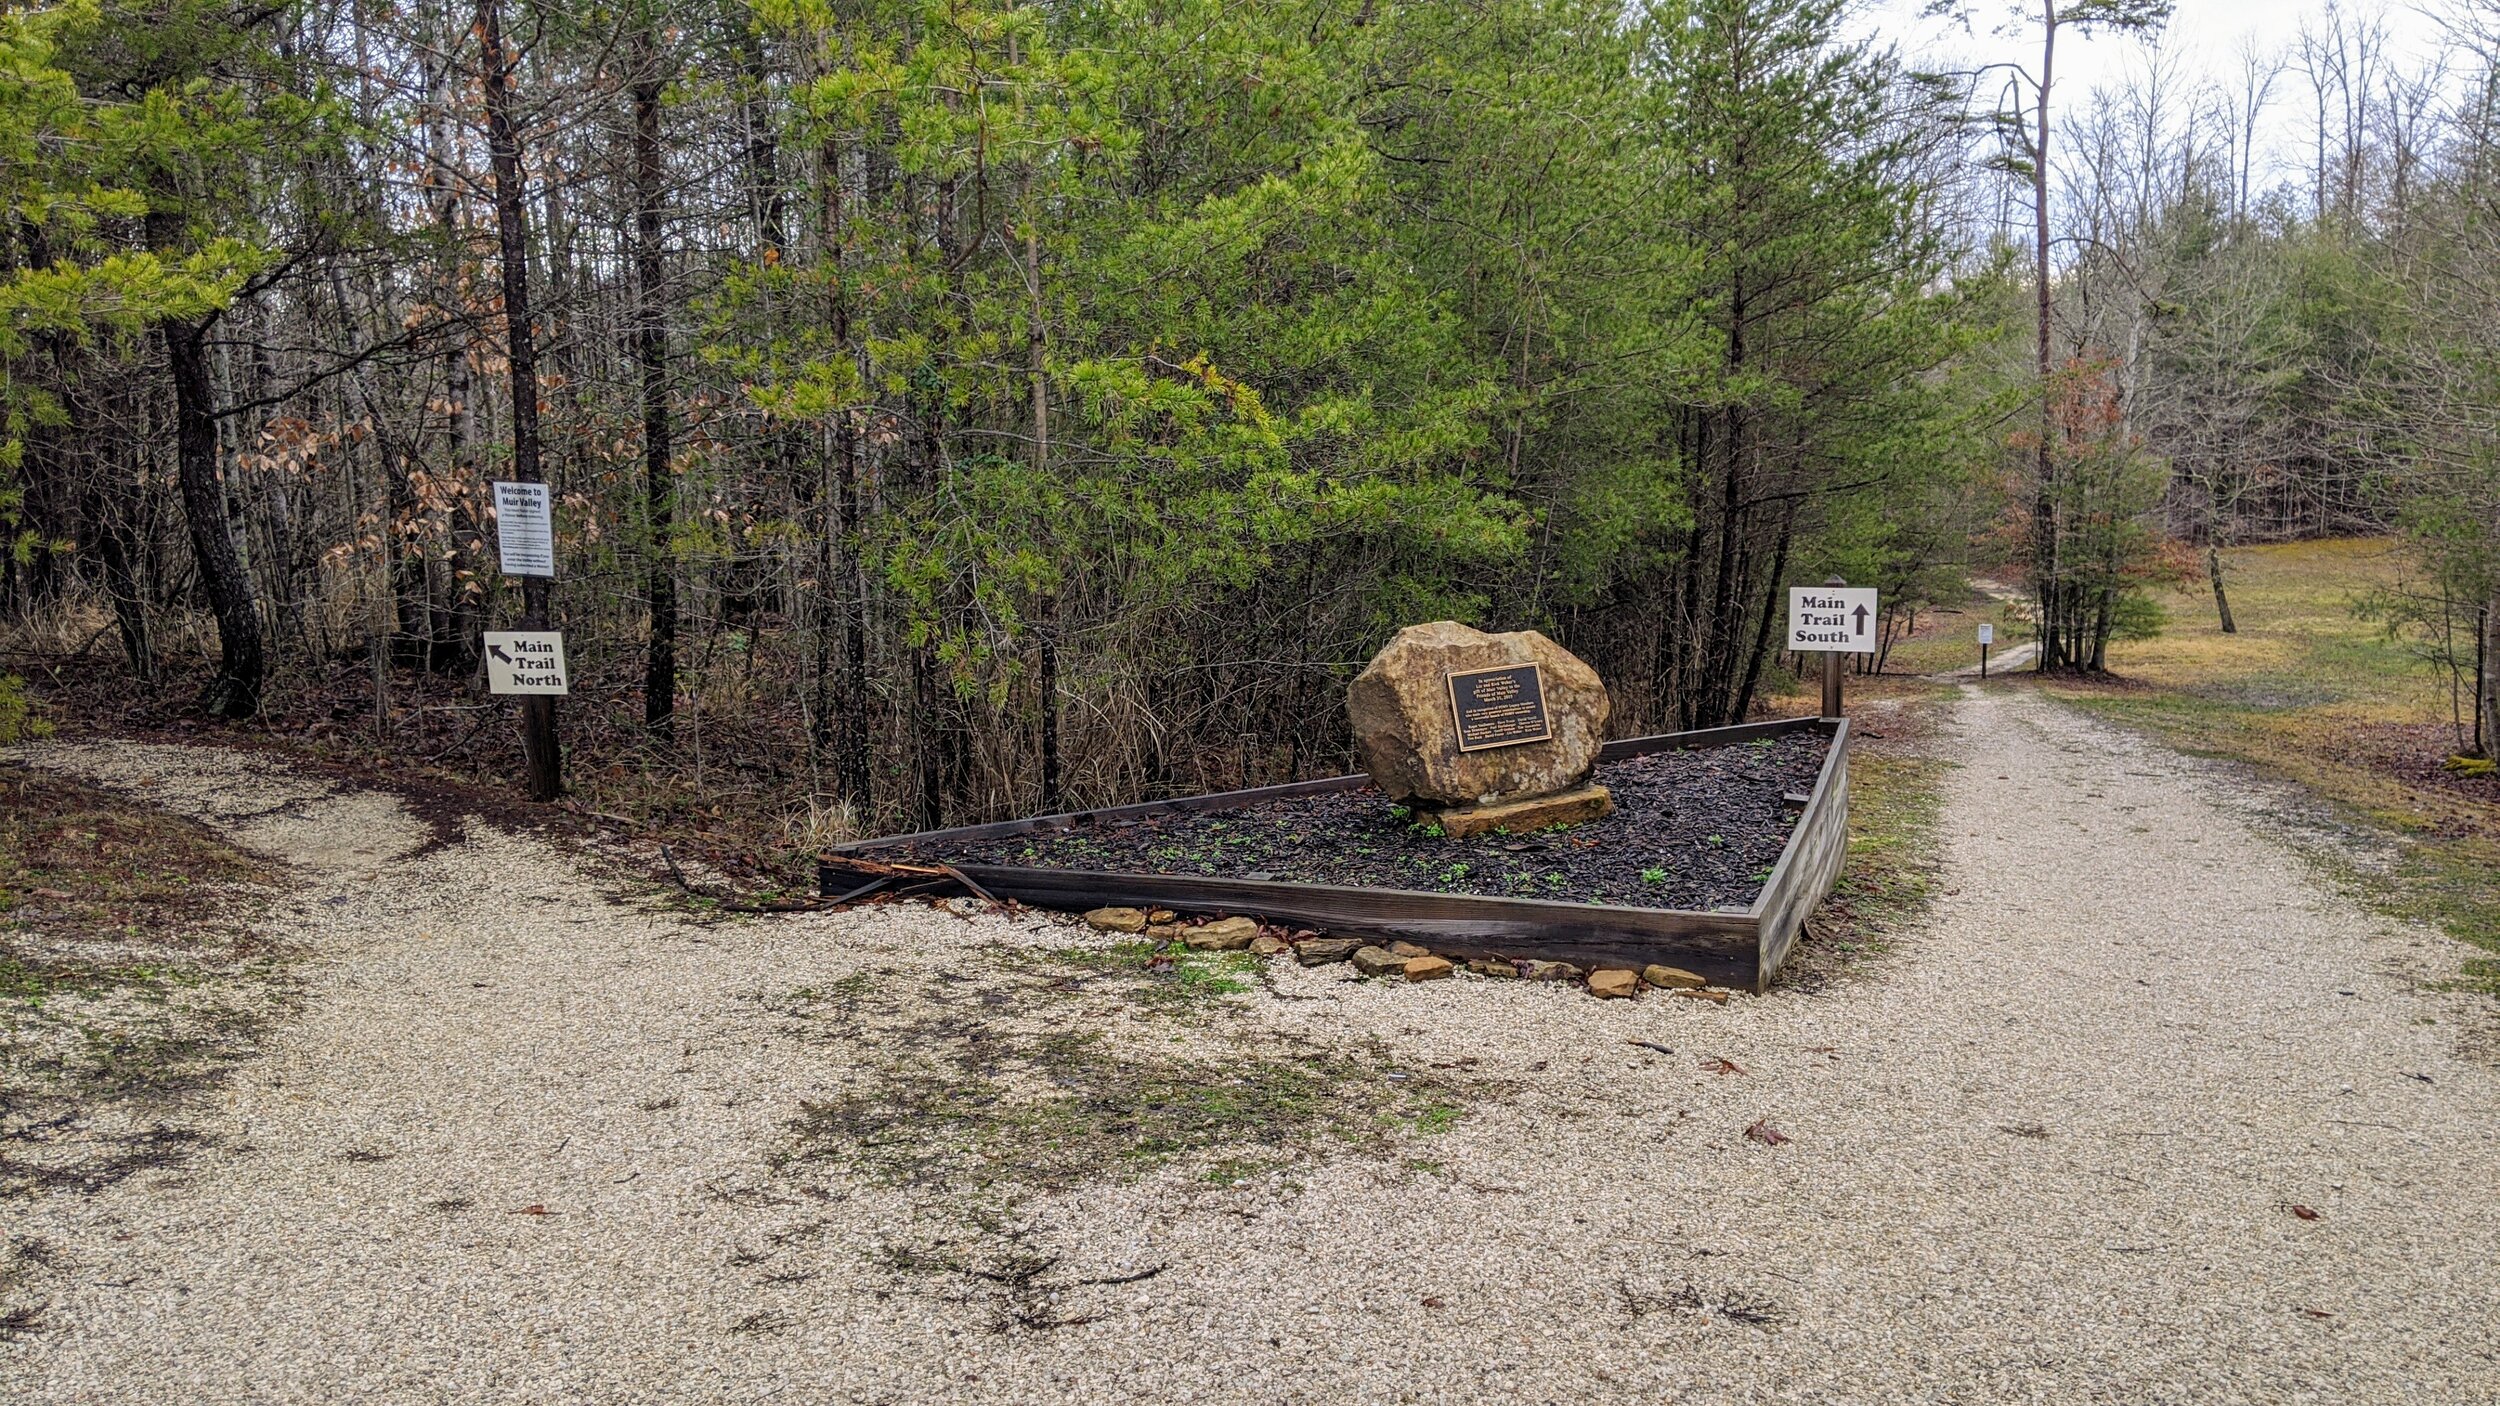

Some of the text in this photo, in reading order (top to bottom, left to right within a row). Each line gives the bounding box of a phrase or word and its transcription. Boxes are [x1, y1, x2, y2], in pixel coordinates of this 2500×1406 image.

[500, 486, 542, 496] Welcome to
[502, 497, 542, 509] Muir Valley
[1801, 596, 1845, 609] Main
[1801, 613, 1845, 626] Trail
[1795, 630, 1849, 643] South
[513, 640, 553, 653] Main
[515, 657, 555, 669] Trail
[512, 674, 562, 686] North
